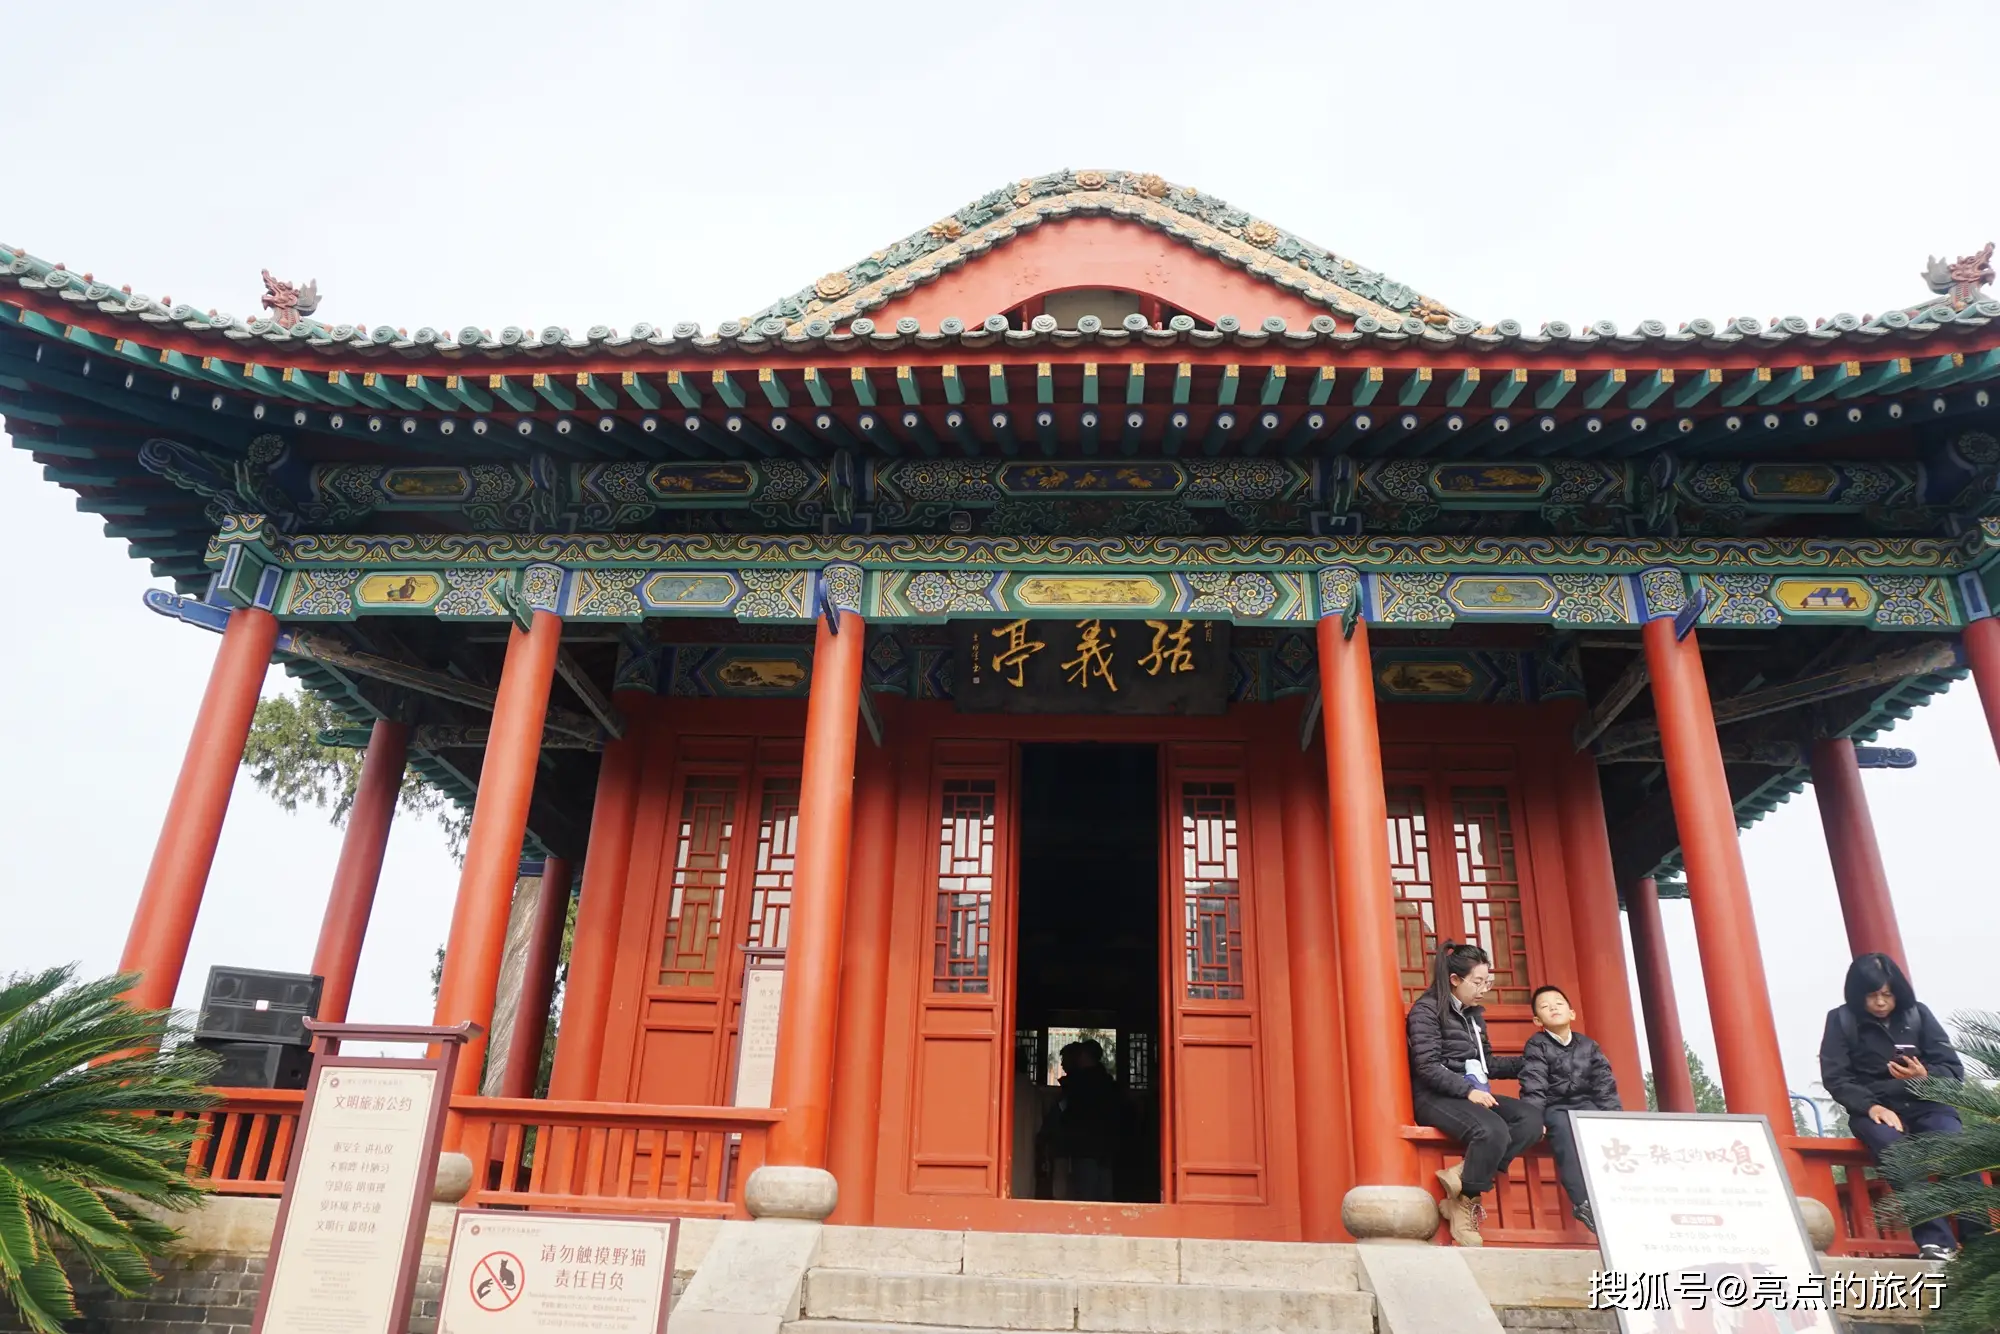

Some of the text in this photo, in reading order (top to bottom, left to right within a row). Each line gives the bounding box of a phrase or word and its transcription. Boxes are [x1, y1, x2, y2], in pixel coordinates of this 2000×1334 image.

[333, 1094, 413, 1113] 文明旅游公约
[315, 1218, 345, 1232] 文明行
[540, 1243, 648, 1267] 请勿触摸野猫
[554, 1269, 626, 1292] 责任自负
